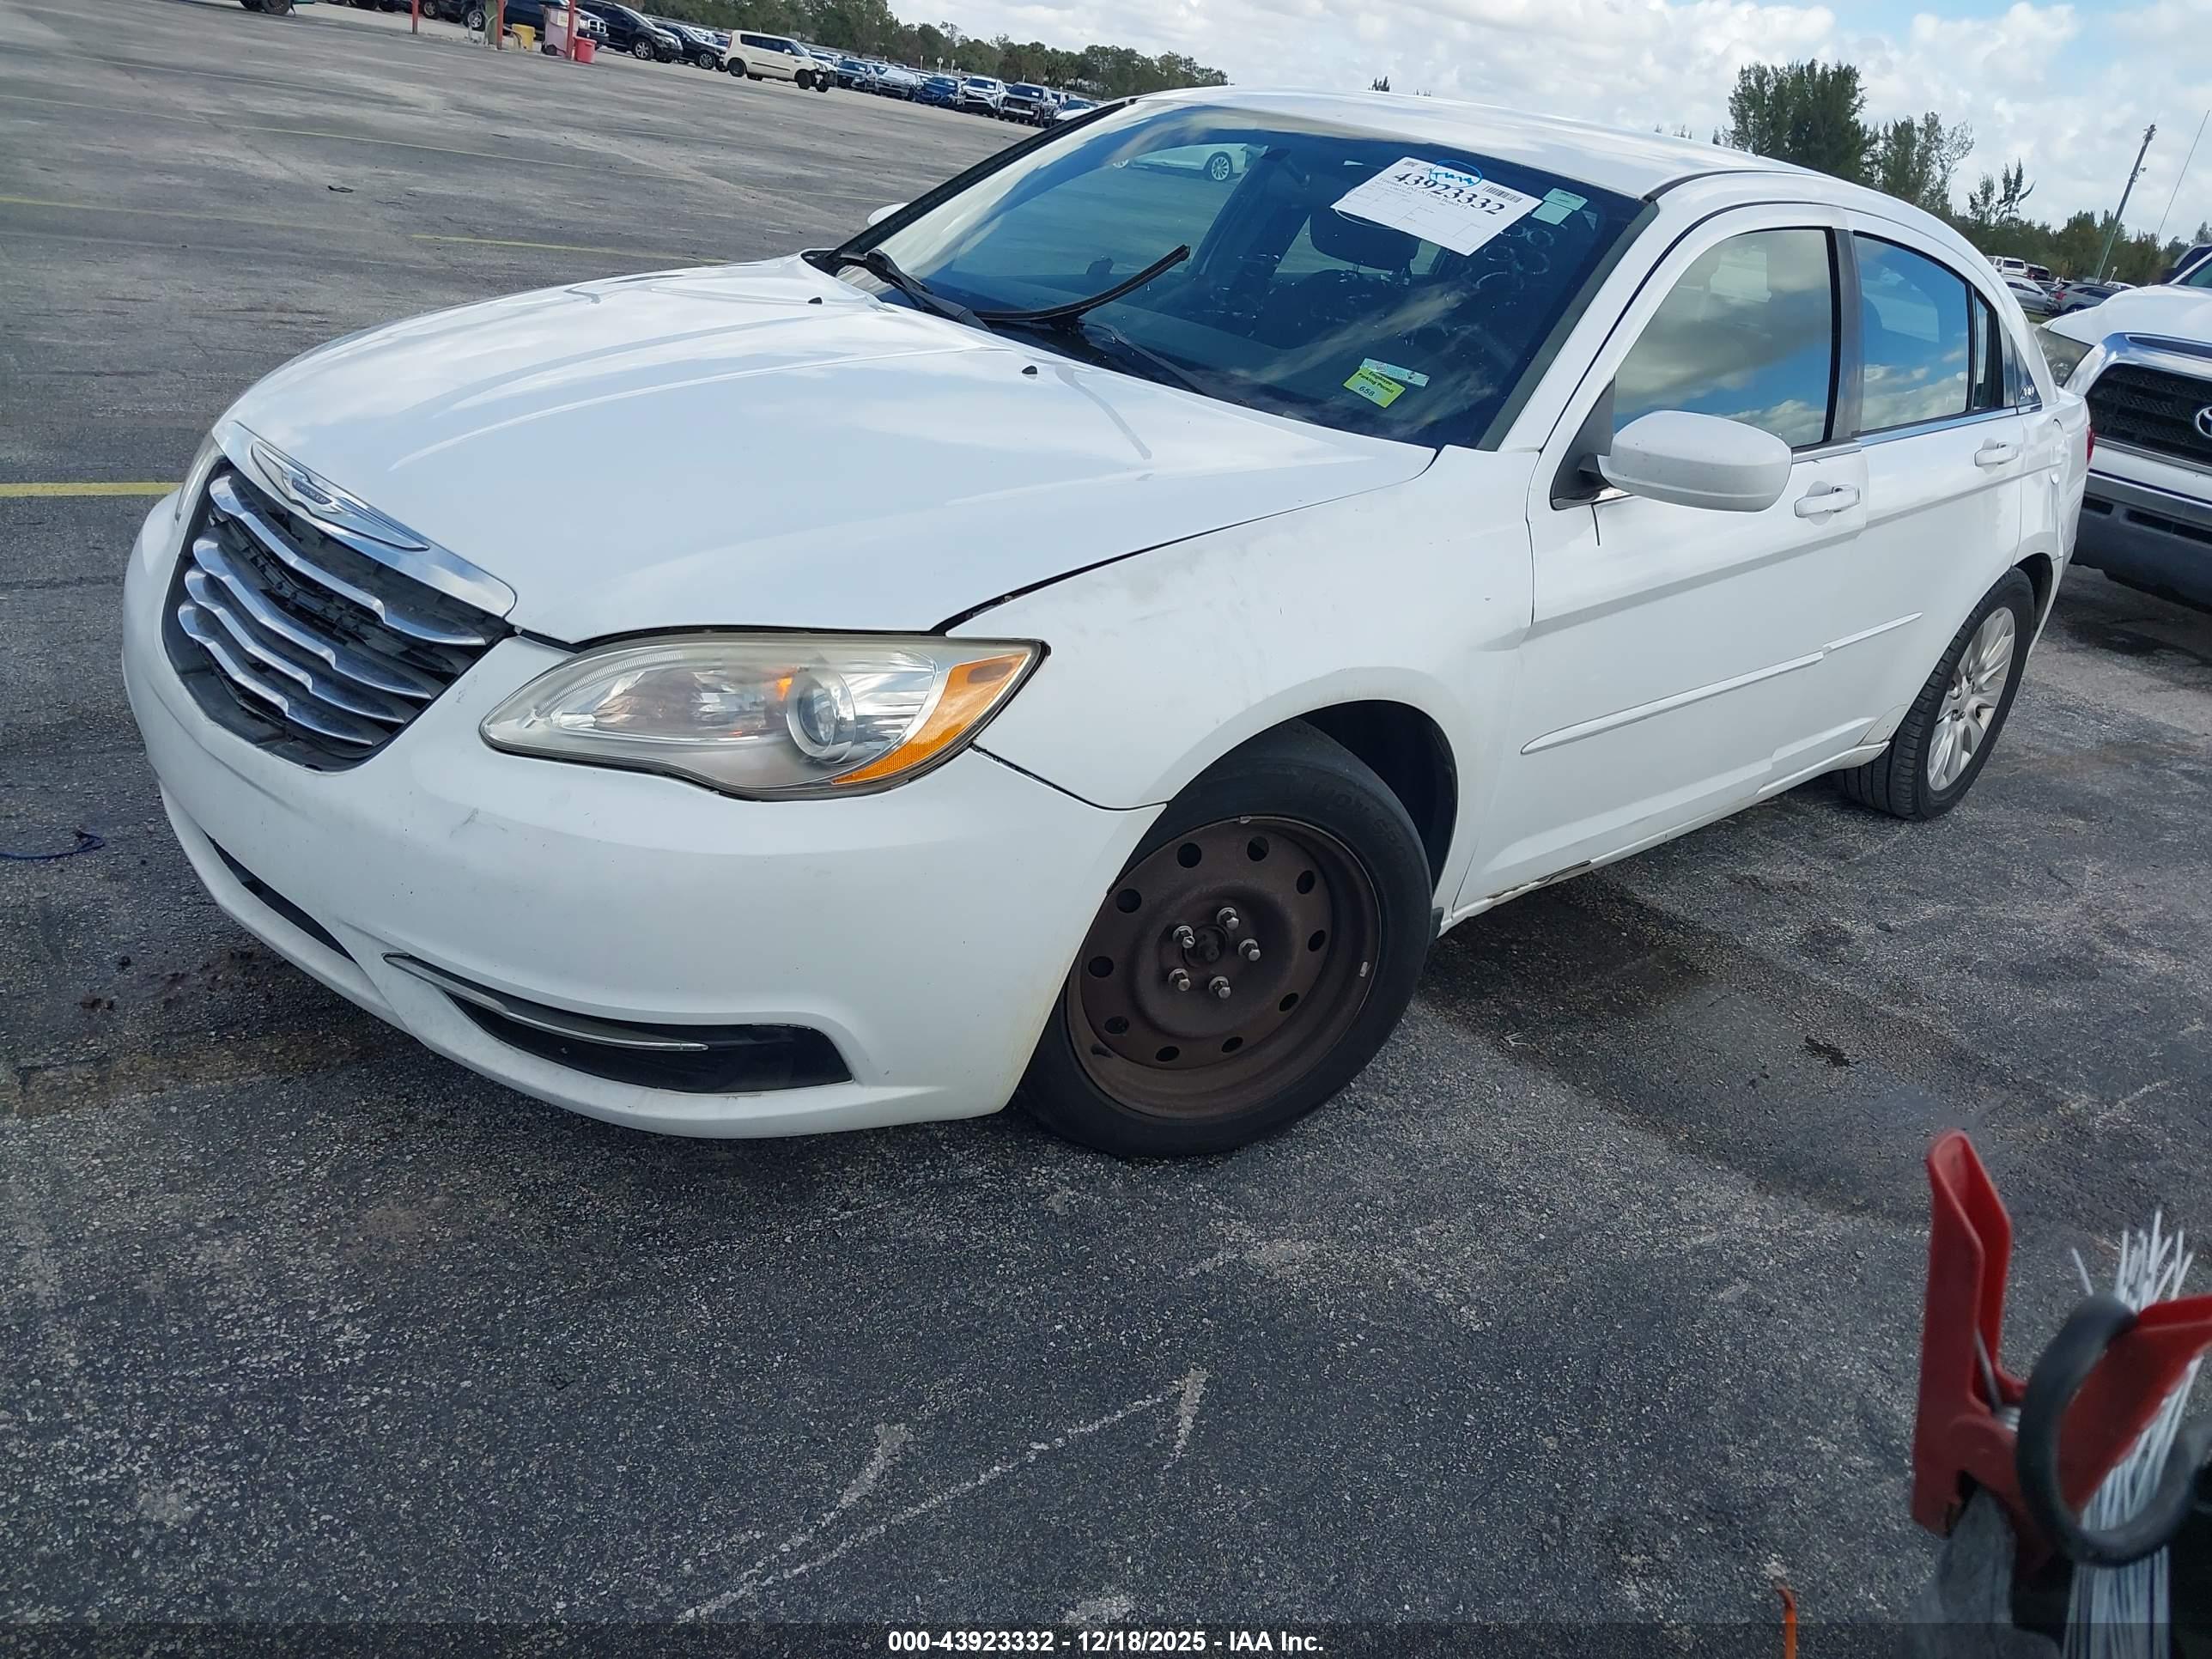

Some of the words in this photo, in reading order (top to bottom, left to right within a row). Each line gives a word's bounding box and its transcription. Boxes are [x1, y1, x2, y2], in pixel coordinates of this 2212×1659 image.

[1393, 172, 1506, 216] 43923332
[1358, 373, 1376, 386] Parking
[1376, 382, 1395, 394] Permit
